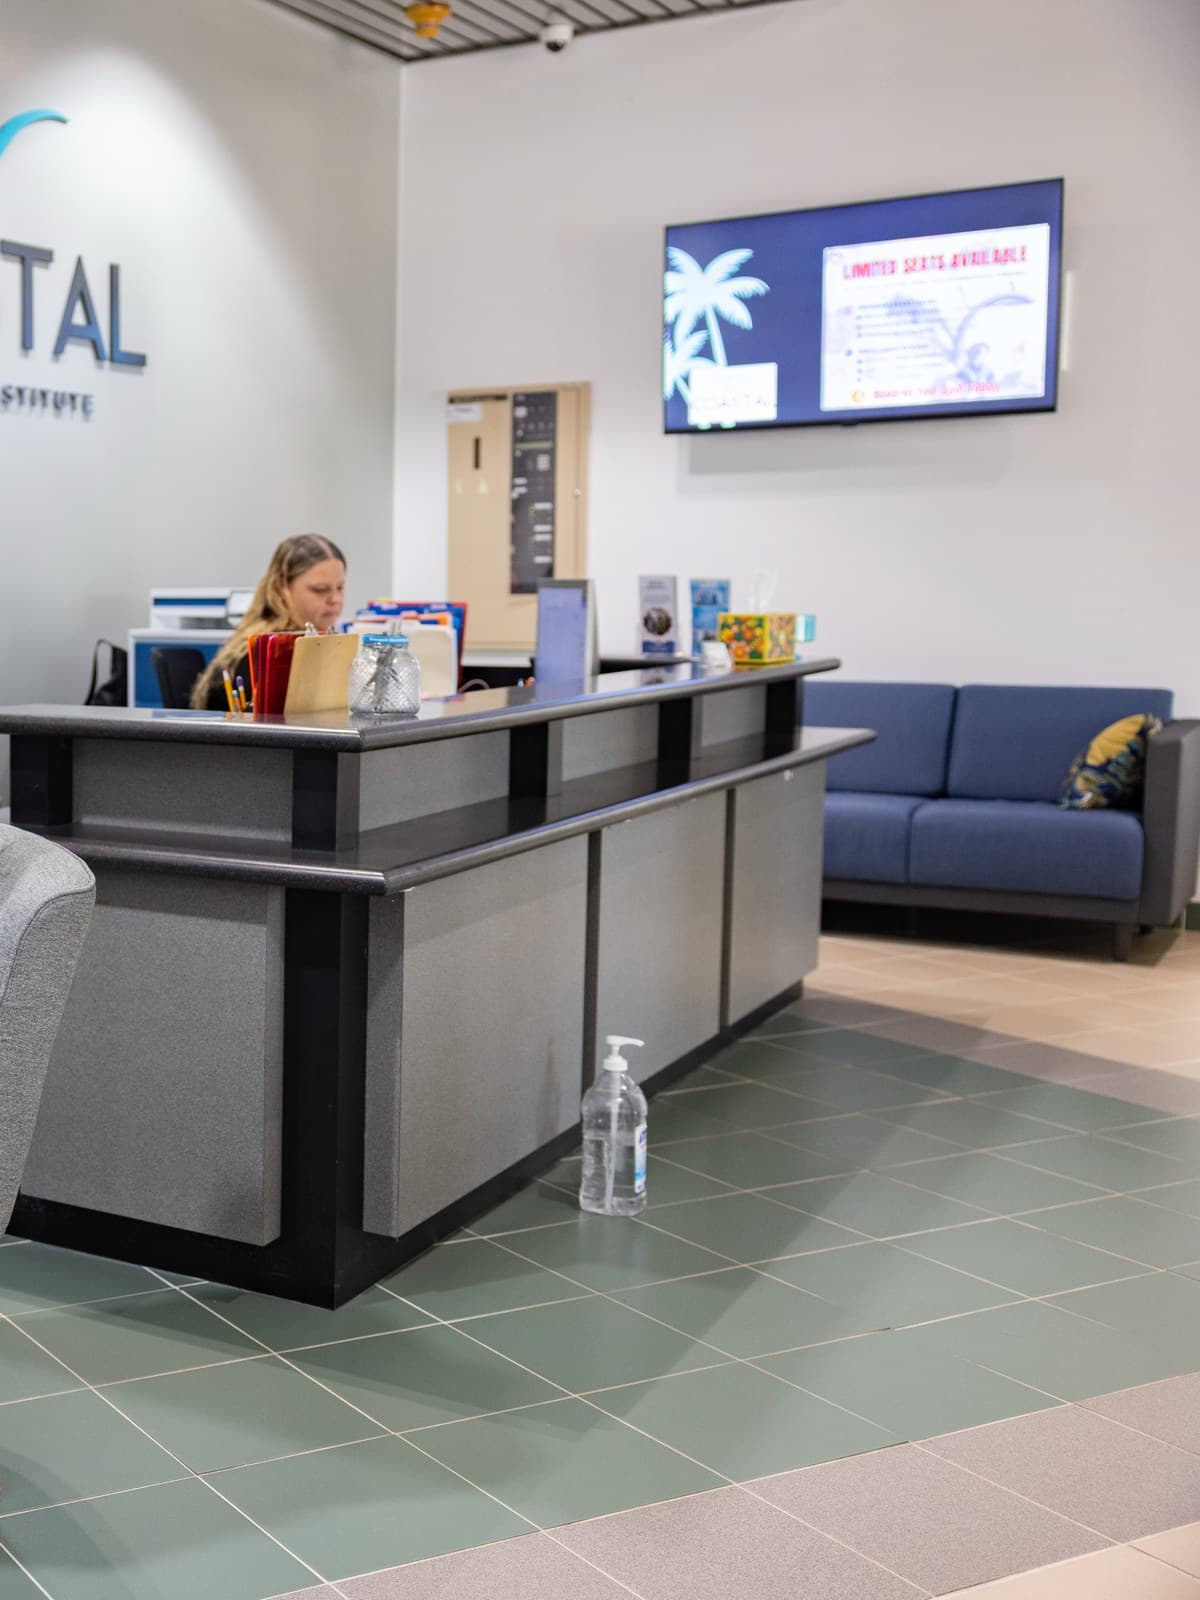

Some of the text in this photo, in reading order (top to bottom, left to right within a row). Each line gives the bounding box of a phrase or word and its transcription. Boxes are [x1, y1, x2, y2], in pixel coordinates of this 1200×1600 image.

[843, 245, 1027, 280] LIMITED SEATS AVAILABLE
